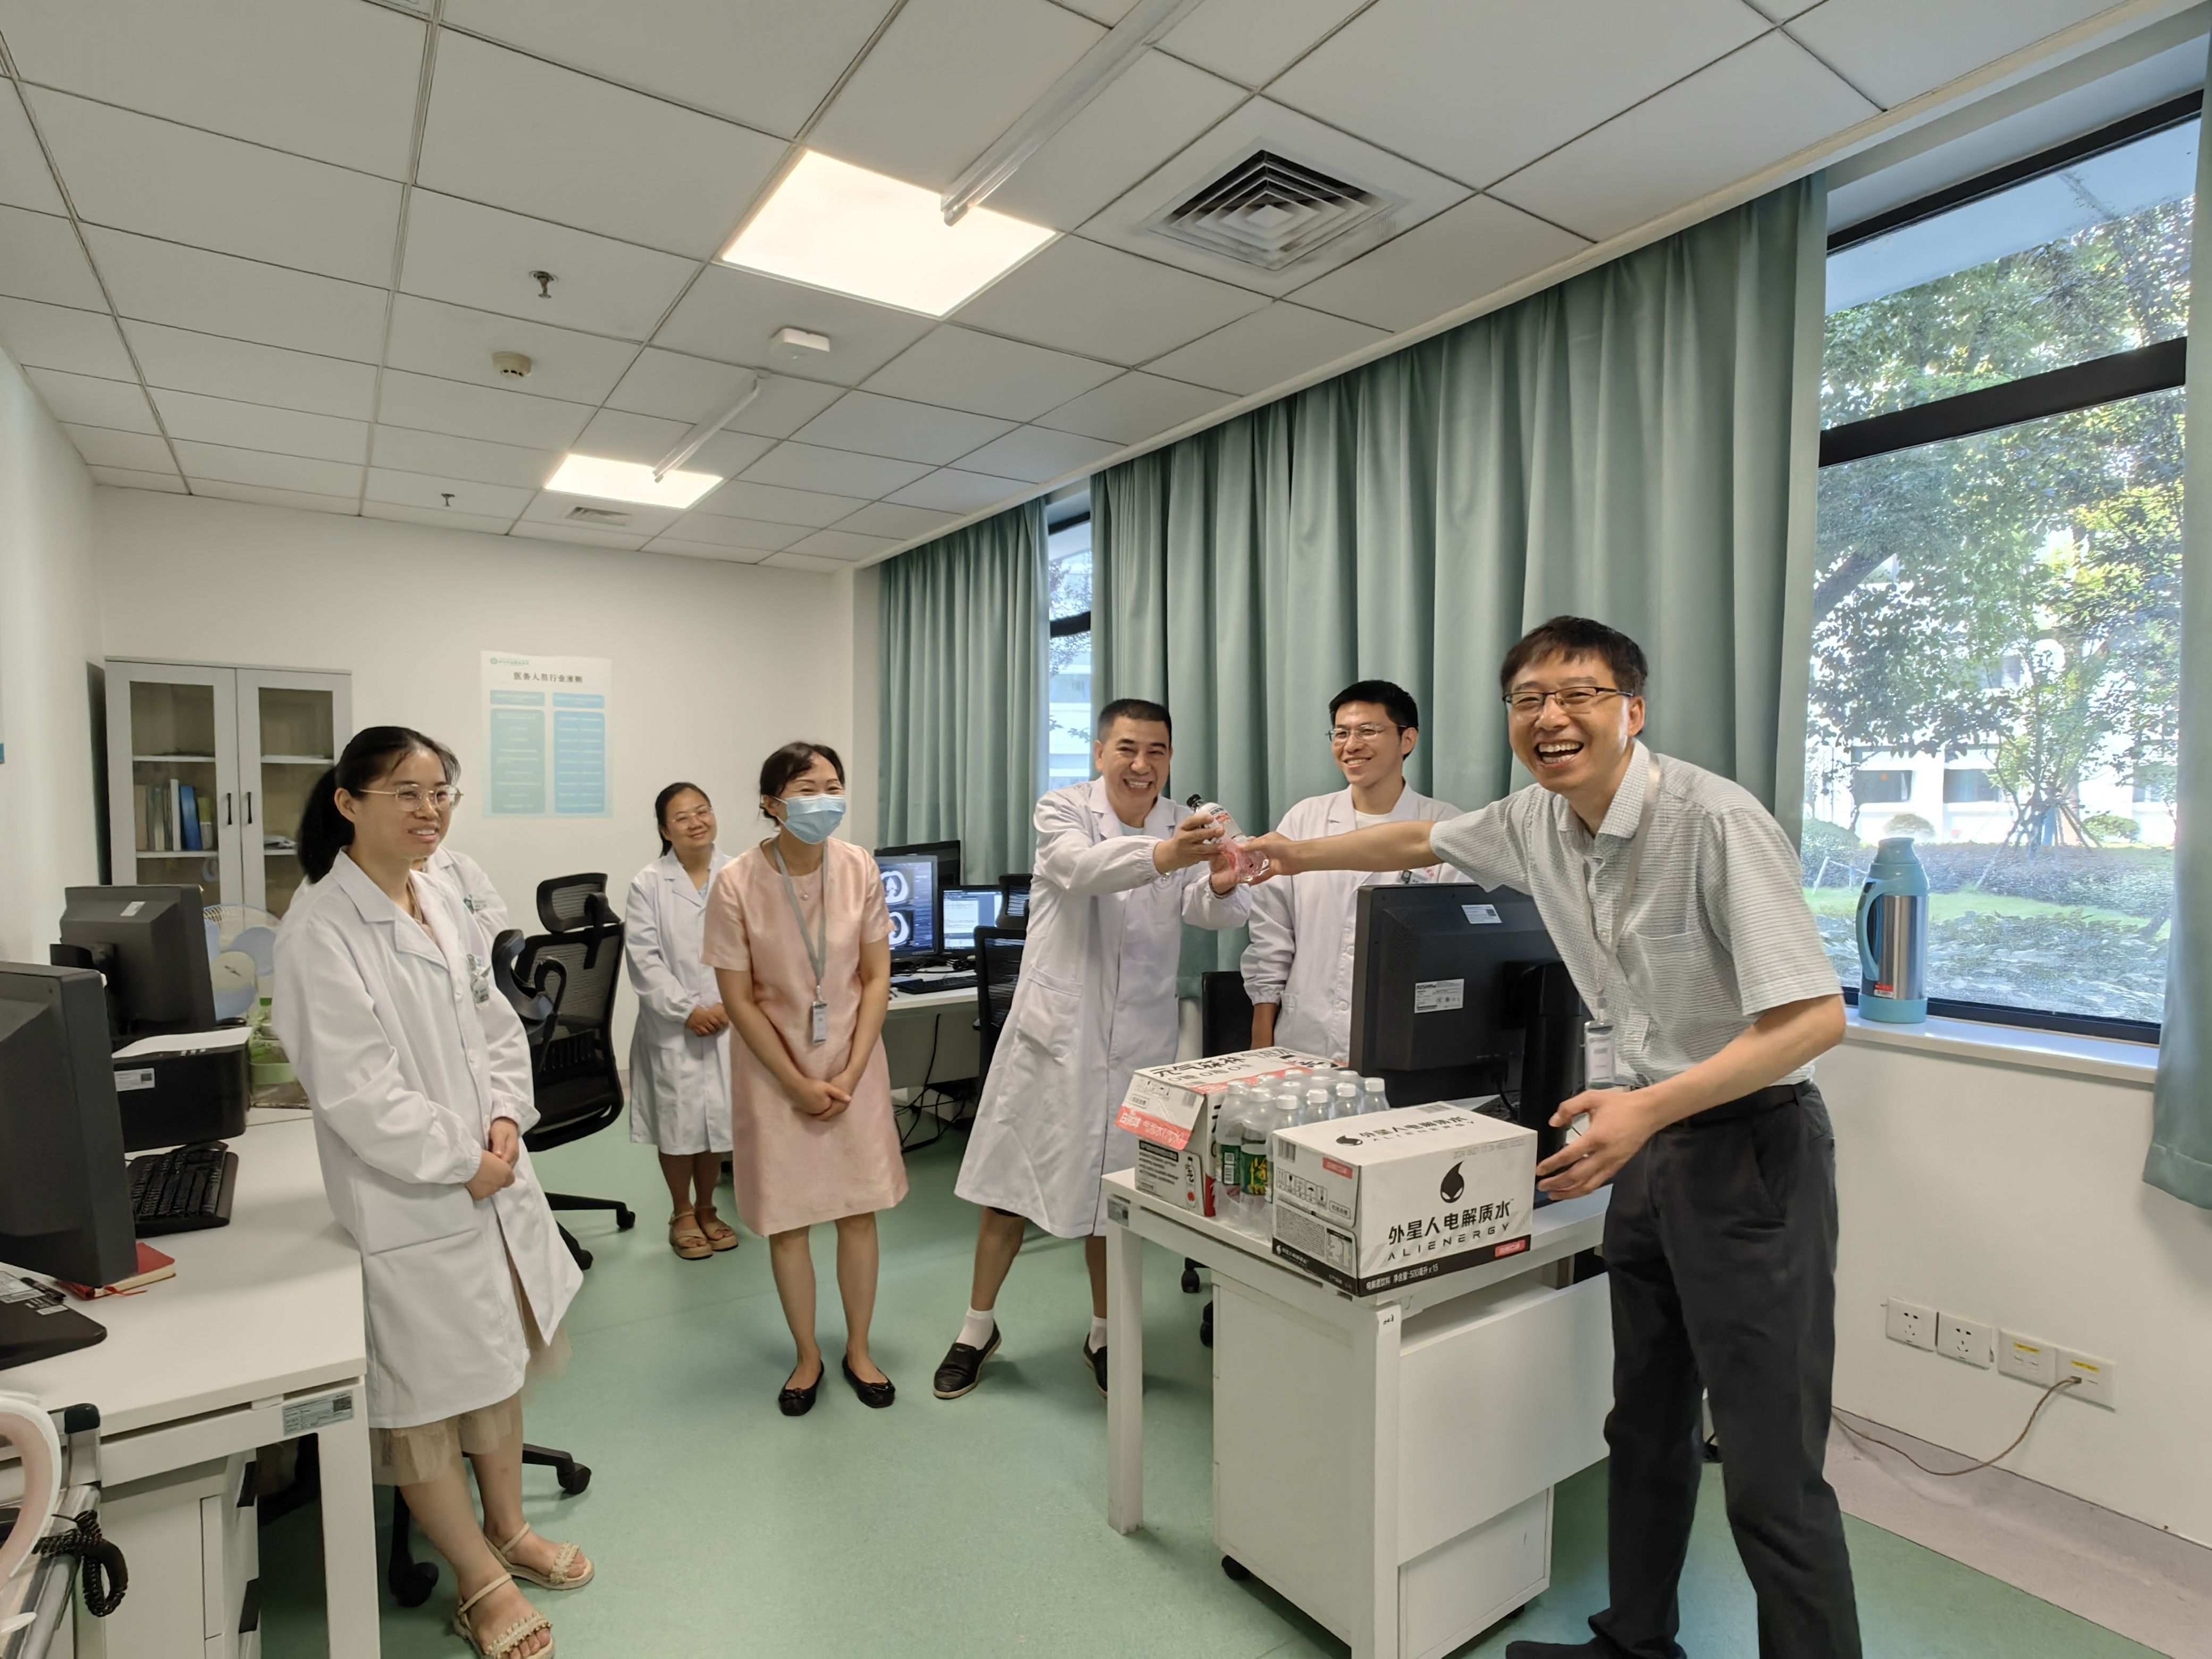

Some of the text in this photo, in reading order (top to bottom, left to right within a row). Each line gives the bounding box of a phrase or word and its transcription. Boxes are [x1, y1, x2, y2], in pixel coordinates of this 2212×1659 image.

[513, 672, 583, 683] 医务人员行业准则
[1151, 1056, 1246, 1077] 元气森林
[1359, 1115, 1468, 1138] 外星人电解质水
[1388, 1200, 1511, 1245] 外星人电解质水
[1387, 1222, 1510, 1262] ALIENERGY
